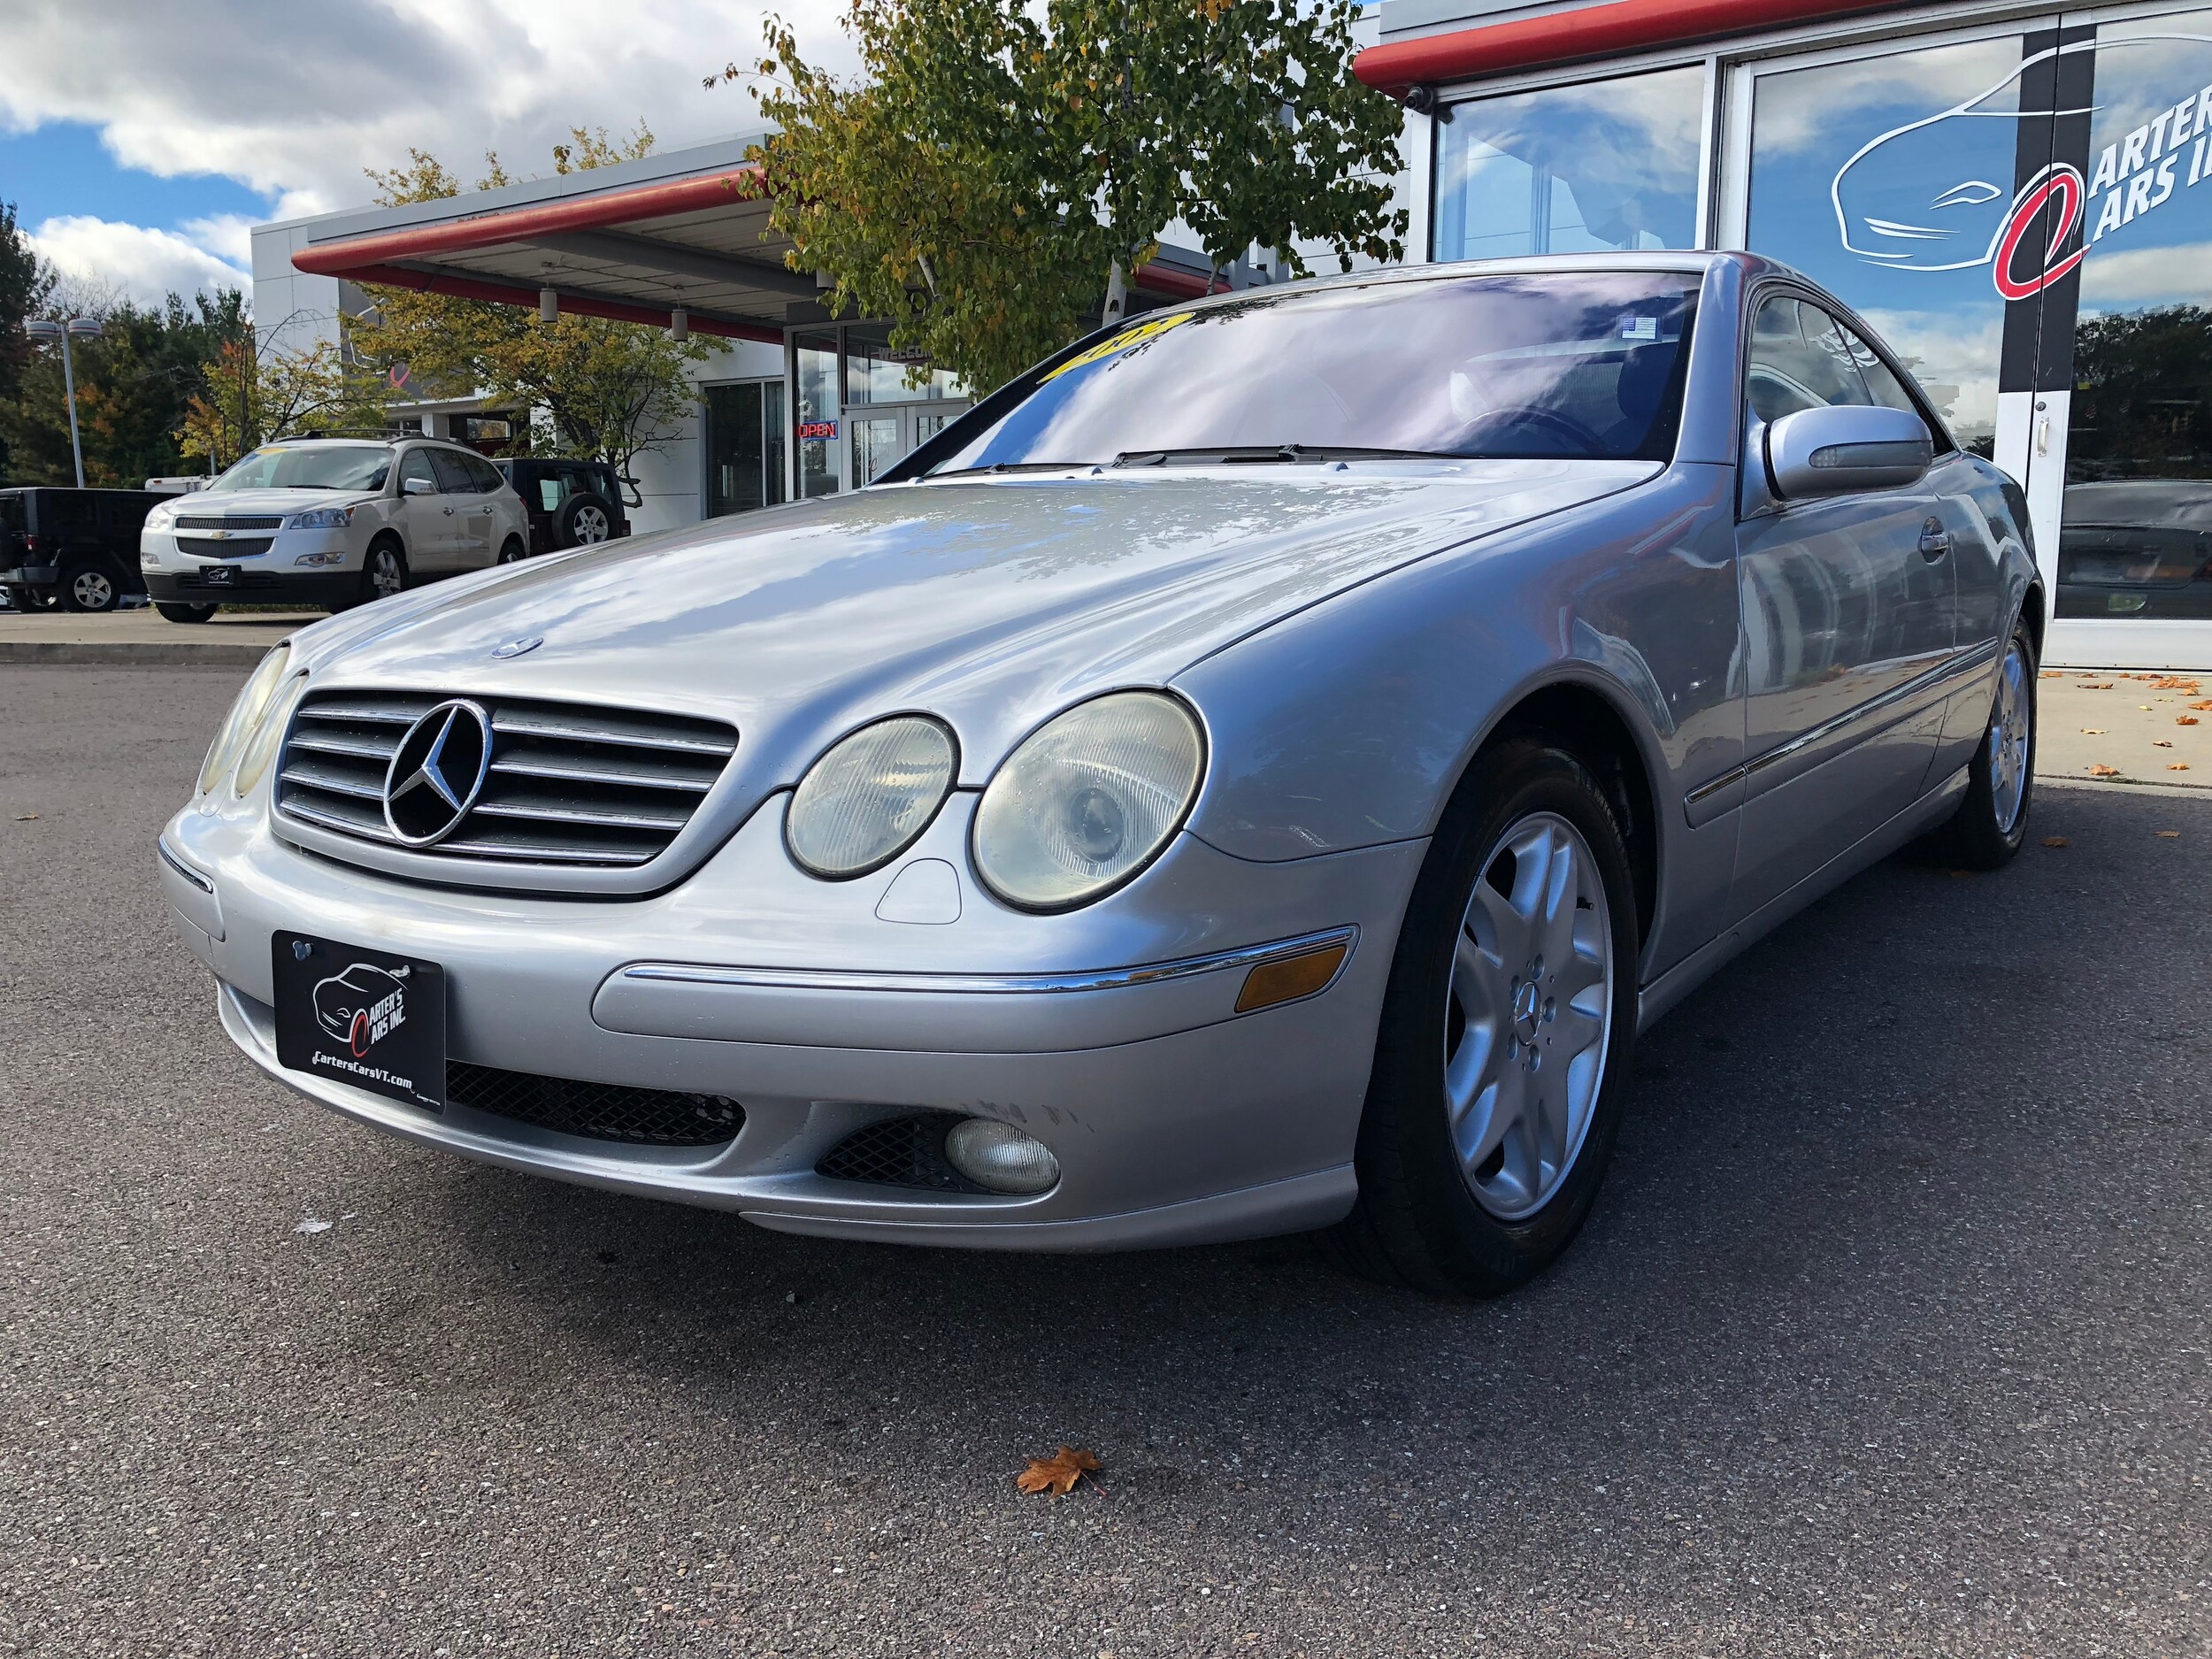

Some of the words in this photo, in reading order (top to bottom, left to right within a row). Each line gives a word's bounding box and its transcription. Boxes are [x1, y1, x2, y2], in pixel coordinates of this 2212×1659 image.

[2092, 151, 2179, 242] ARS
[798, 422, 835, 439] OPEN
[371, 1016, 388, 1045] ARS
[314, 1050, 412, 1089] CartersCarsVT.com
